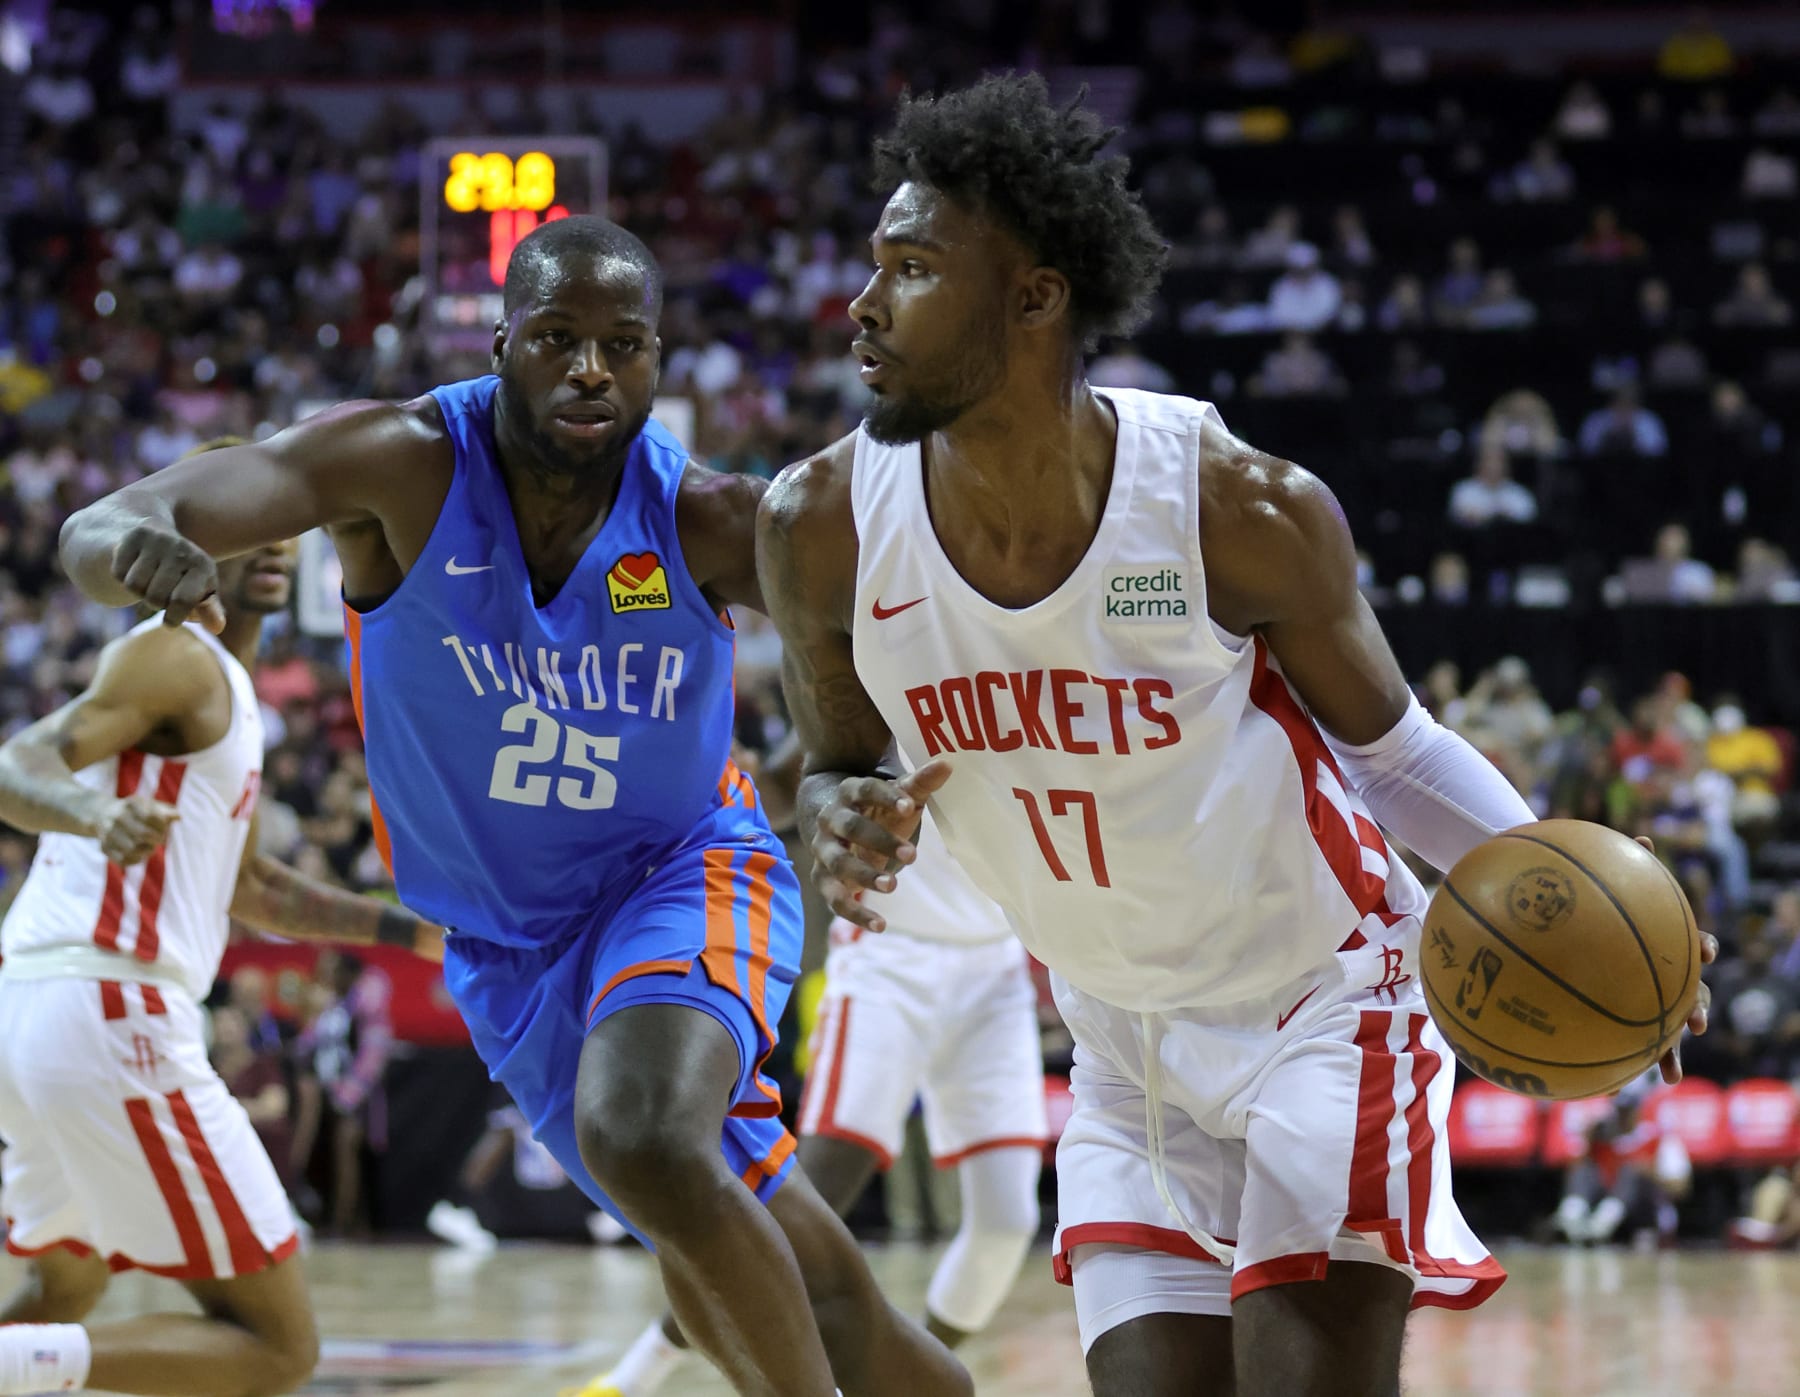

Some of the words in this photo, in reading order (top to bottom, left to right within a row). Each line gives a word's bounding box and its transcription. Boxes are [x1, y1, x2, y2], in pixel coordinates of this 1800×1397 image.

[1106, 595, 1187, 616] karma
[1111, 569, 1182, 592] credit
[489, 702, 620, 810] 25
[904, 669, 1181, 757] ROCKETS
[1012, 787, 1111, 888] 17
